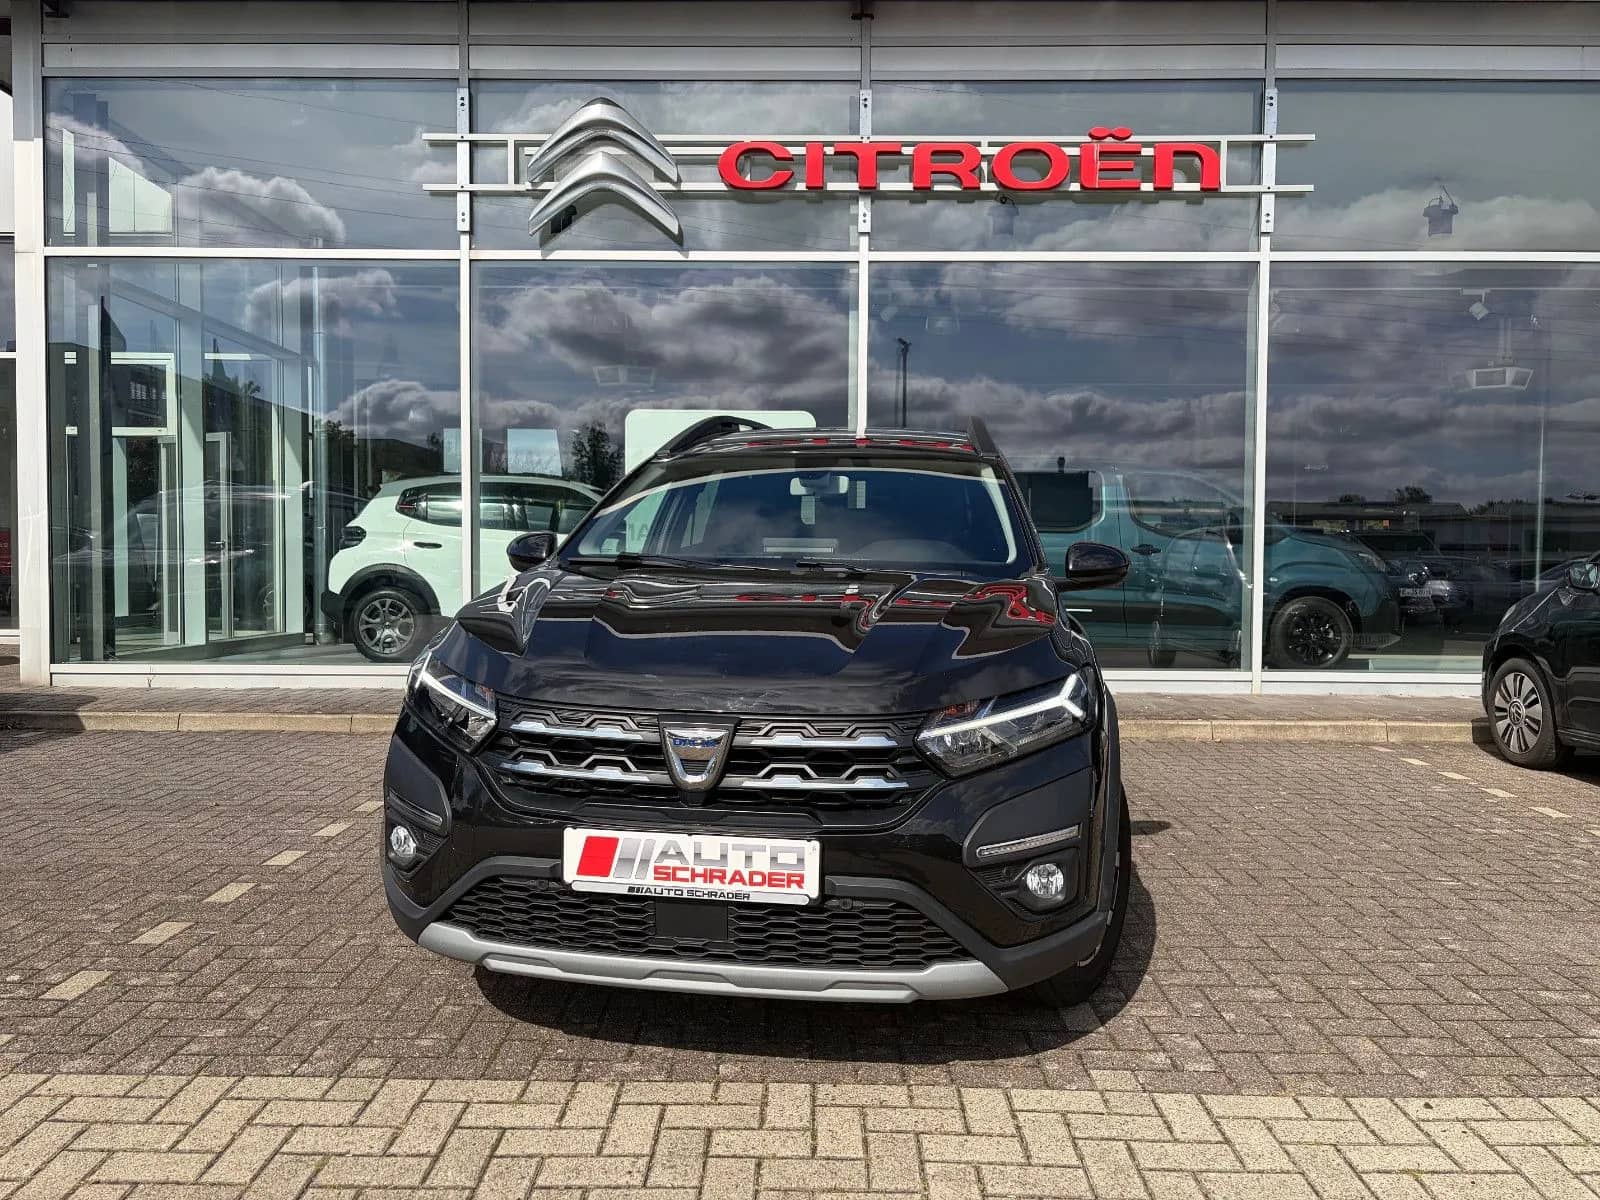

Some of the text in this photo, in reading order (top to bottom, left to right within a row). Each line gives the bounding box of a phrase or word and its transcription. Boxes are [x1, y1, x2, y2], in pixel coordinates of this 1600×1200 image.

[717, 126, 1221, 191] CITROËN
[653, 839, 806, 871] AUTO
[653, 865, 806, 889] SCHRADER
[645, 886, 750, 900] AUTO SCHRADER
